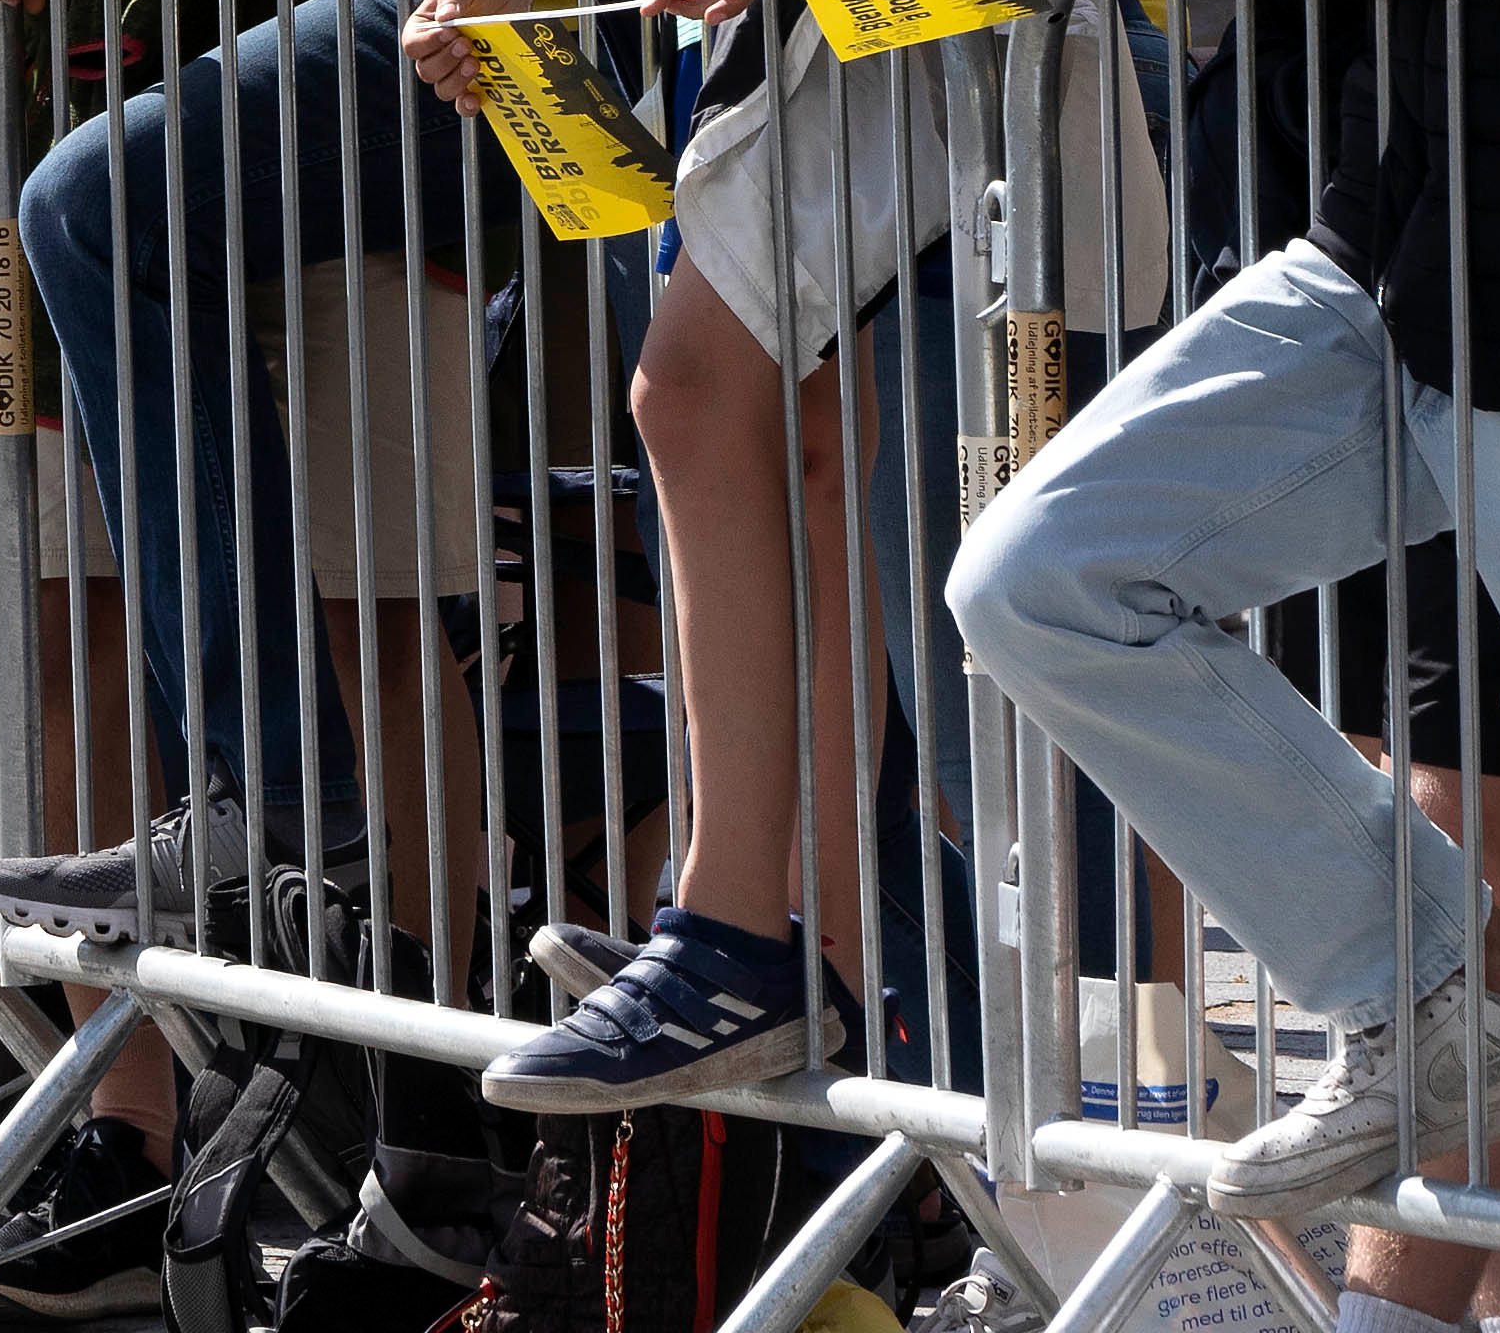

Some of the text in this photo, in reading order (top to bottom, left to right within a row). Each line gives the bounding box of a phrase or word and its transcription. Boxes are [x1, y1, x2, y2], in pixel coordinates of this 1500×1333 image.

[472, 37, 568, 155] Roskilde
[560, 161, 585, 177] à
[1025, 321, 1038, 373] Udlejning
[19, 364, 28, 374] af
[1028, 376, 1038, 388] af
[20, 379, 30, 425] Udlejning
[975, 447, 988, 499] Udlejning
[1158, 1281, 1247, 1318] gøre flere
[1181, 1300, 1273, 1332] med til at
